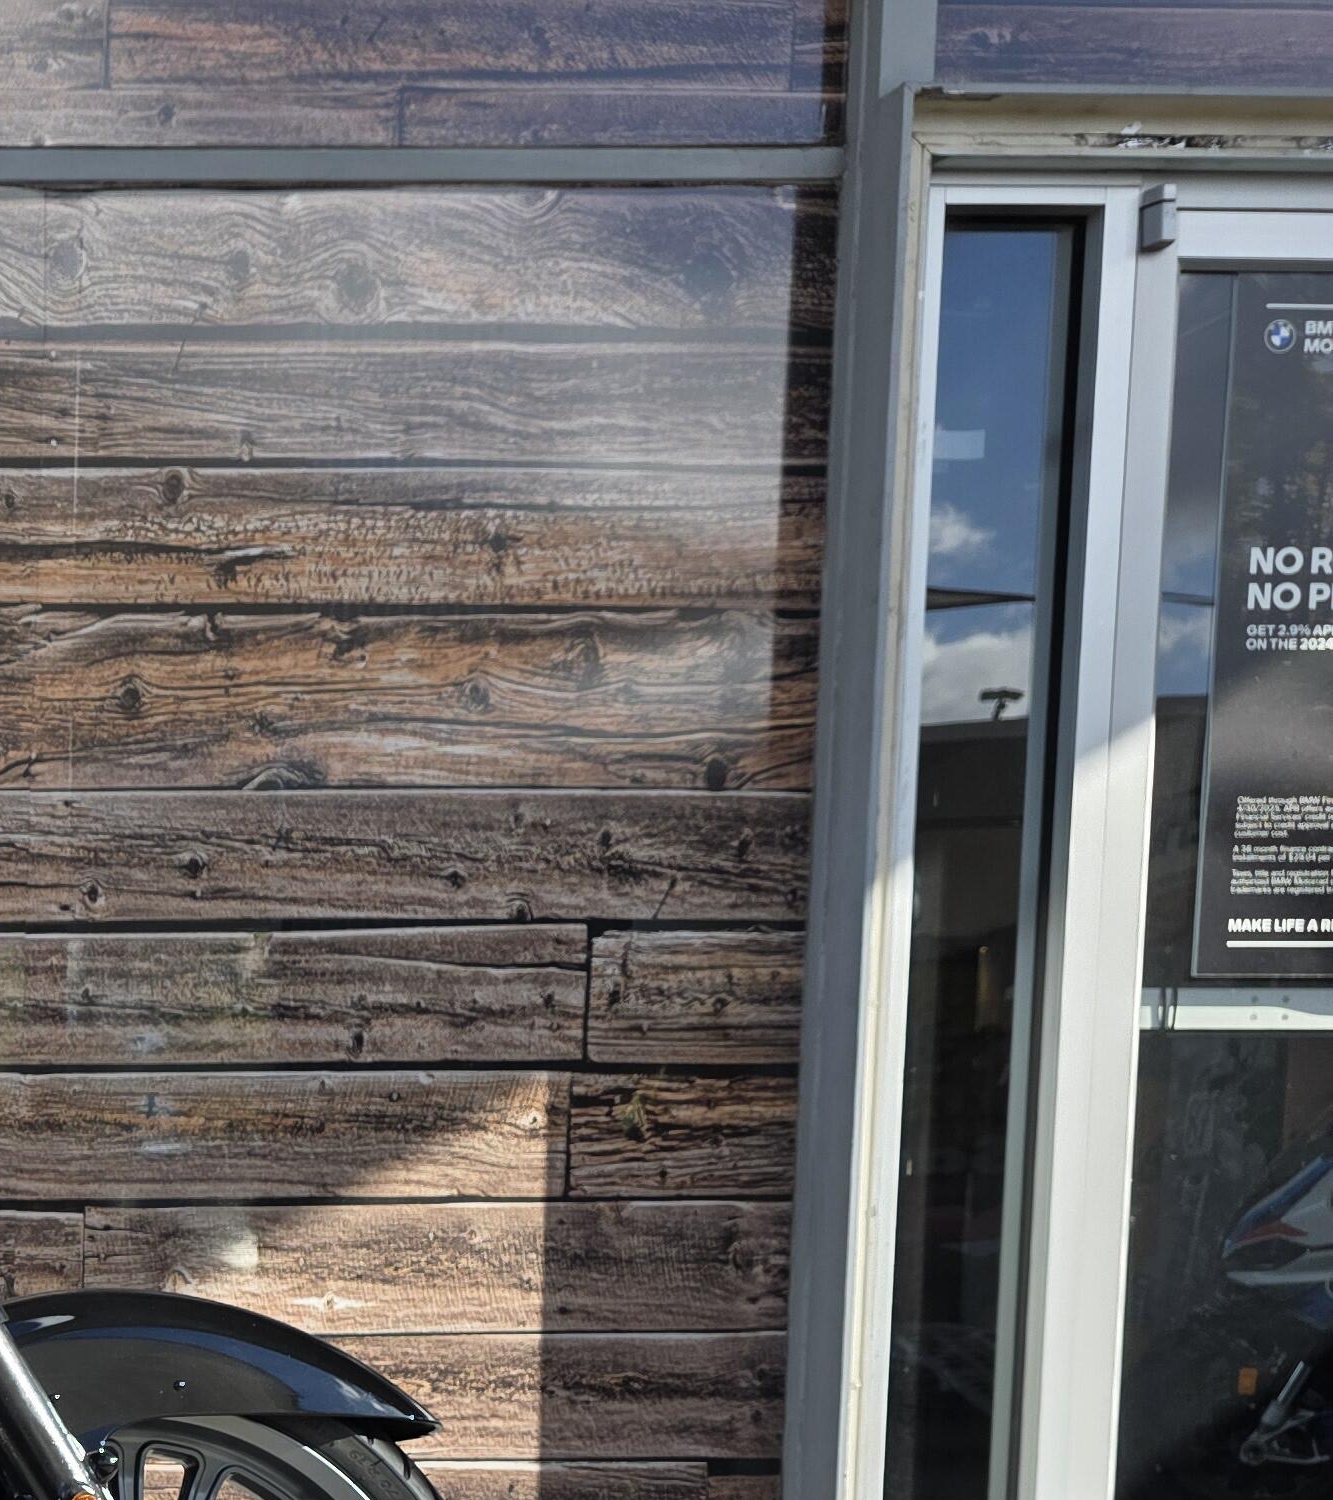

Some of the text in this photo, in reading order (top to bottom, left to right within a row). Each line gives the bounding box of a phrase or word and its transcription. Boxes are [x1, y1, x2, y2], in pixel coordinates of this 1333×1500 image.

[1305, 320, 1333, 336] BM
[1250, 546, 1304, 575] NO
[1247, 582, 1333, 611] NO P
[1247, 624, 1275, 637] GET
[1313, 624, 1333, 637] AP
[1246, 638, 1267, 651] ON
[1270, 638, 1298, 651] THE
[1228, 918, 1333, 932] MAKE LIFE A R
